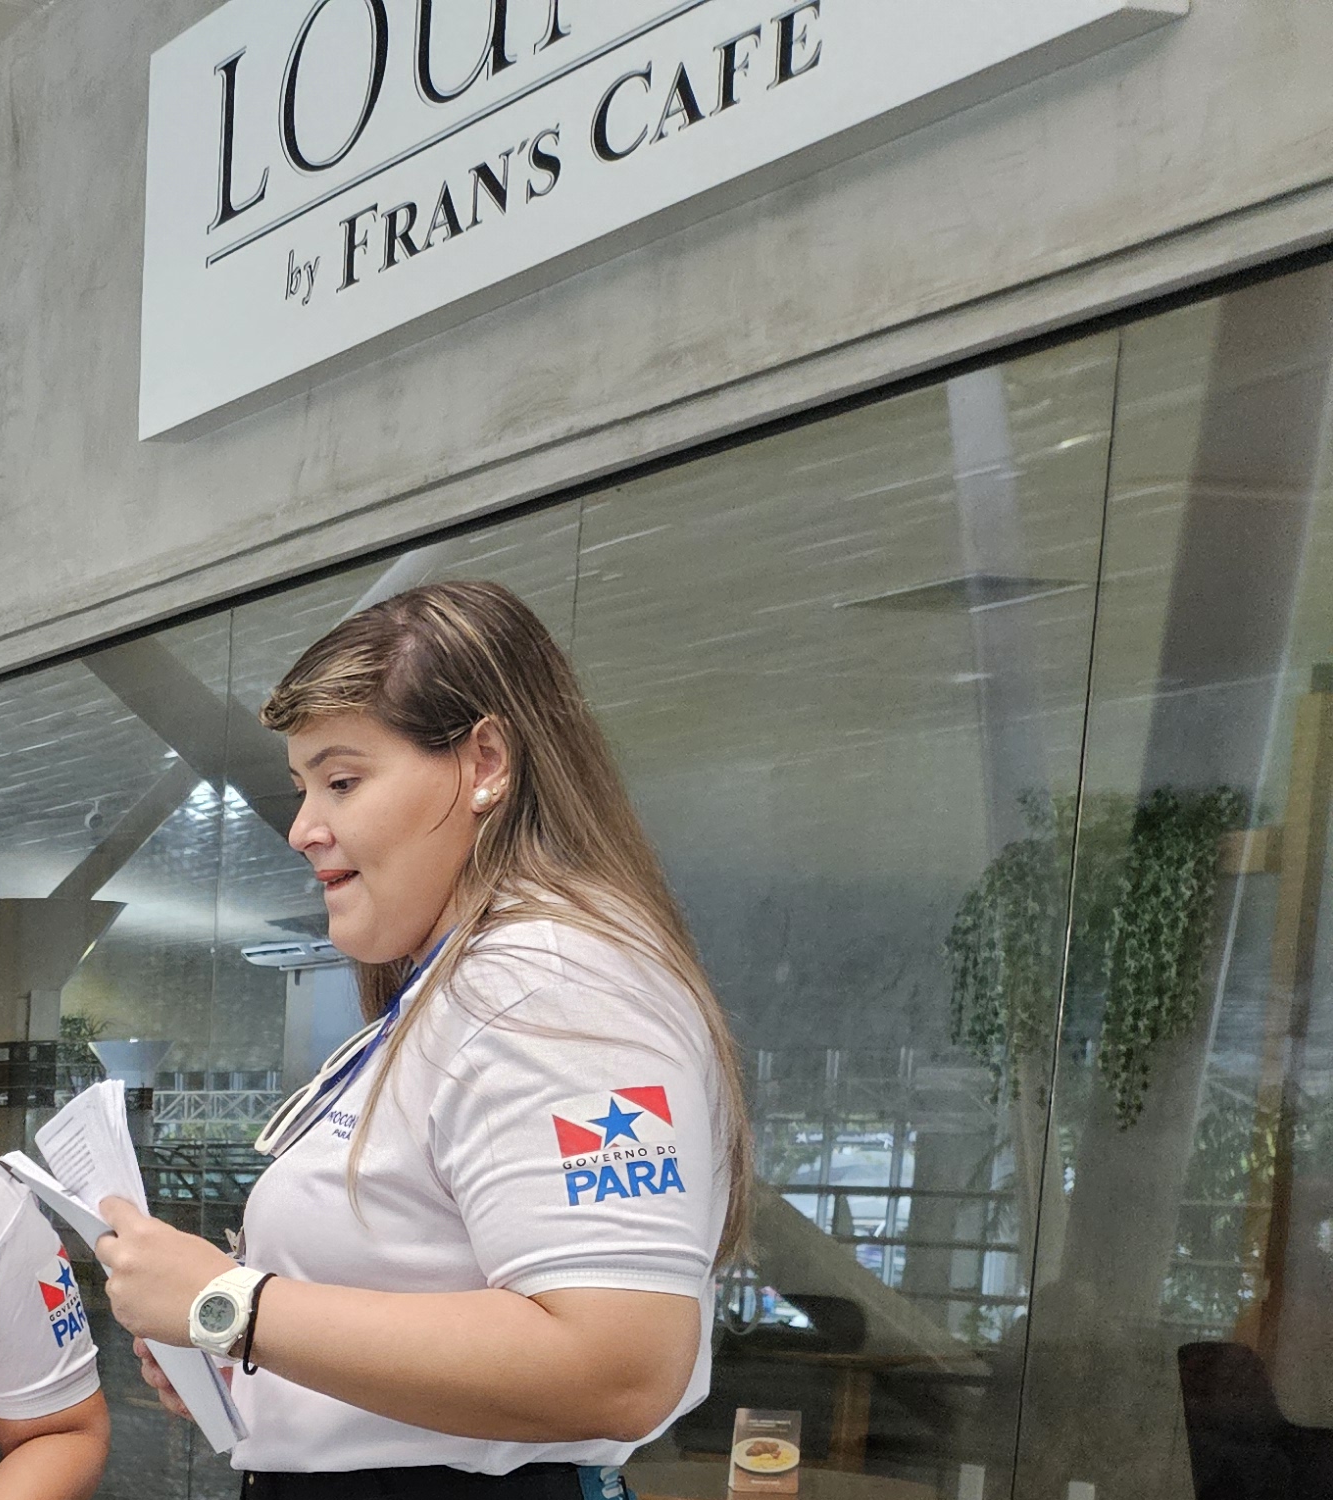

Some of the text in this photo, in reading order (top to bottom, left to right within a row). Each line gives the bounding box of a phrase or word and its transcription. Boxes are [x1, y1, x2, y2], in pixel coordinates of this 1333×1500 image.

[206, 0, 572, 234] LOU
[284, 249, 321, 306] by
[562, 1145, 677, 1170] GOVERNO DO
